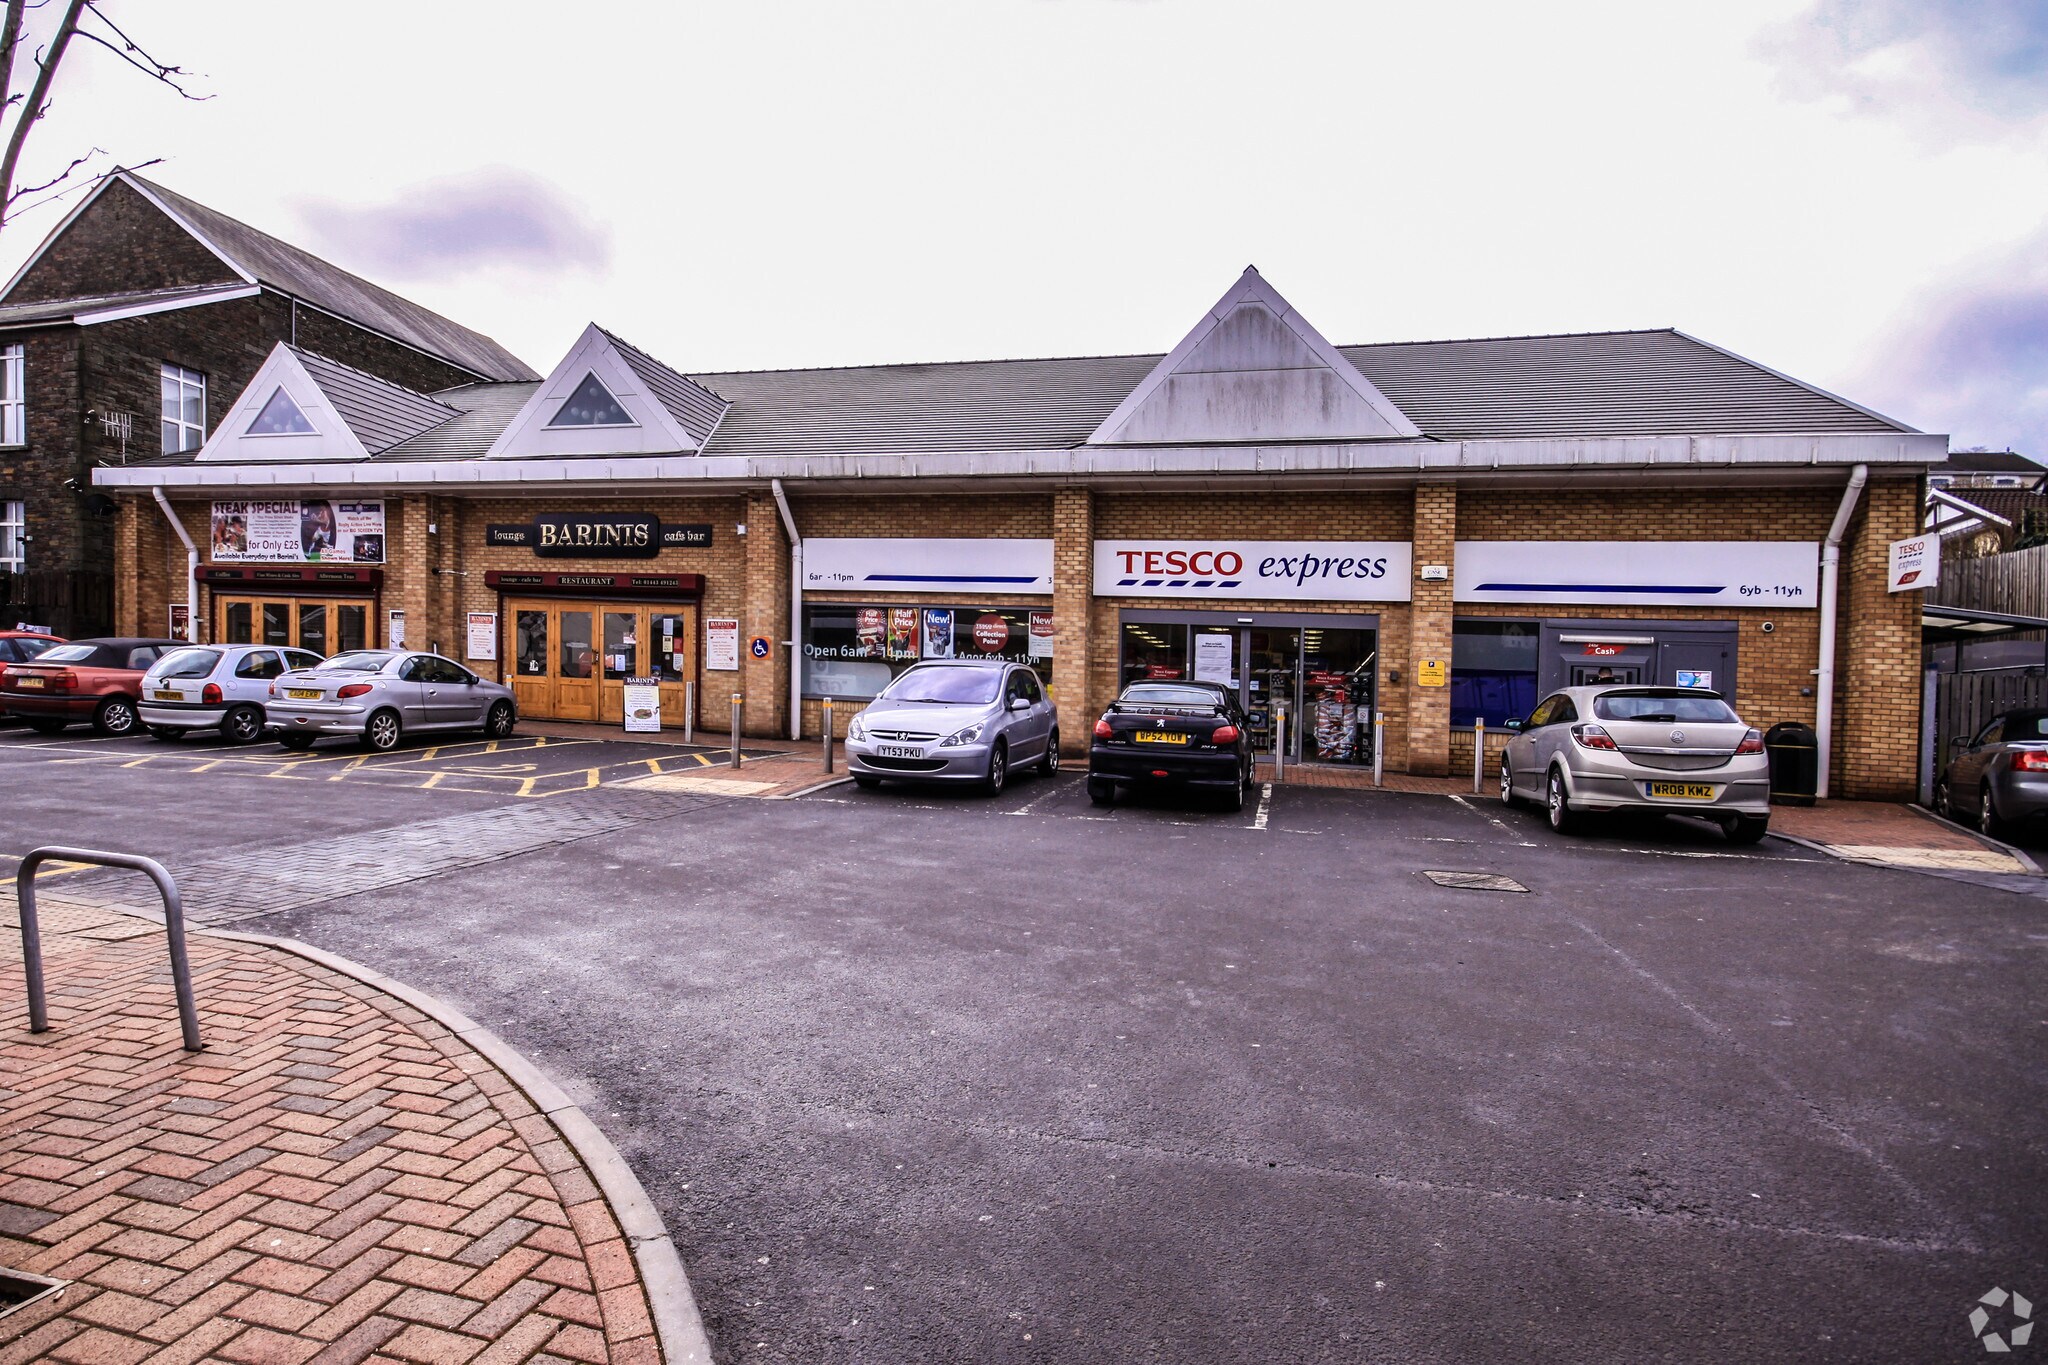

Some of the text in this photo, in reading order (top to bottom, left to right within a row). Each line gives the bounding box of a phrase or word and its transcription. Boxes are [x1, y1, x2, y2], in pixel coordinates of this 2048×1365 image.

[214, 501, 299, 514] STEAK SPECIAL
[494, 530, 525, 541] lounge
[539, 523, 649, 547] BARINIS
[664, 530, 705, 541] cafe bar
[248, 540, 299, 552] for Only £25
[1898, 541, 1925, 555] TESCO
[1116, 550, 1387, 587] TESCO express
[1897, 558, 1922, 571] express
[561, 576, 612, 585] RESTAURANT
[833, 573, 854, 582] 11pm
[1739, 585, 1762, 597] 6yb
[1773, 586, 1802, 598] 11yh
[896, 609, 913, 618] Half
[927, 613, 950, 624] New!
[894, 617, 914, 627] Price
[1032, 615, 1054, 625] New!
[975, 630, 1006, 638] Collection
[982, 637, 999, 645] Point
[804, 643, 837, 658] Open
[840, 644, 868, 658] 6am
[881, 644, 915, 661] 11pm
[1594, 647, 1615, 655] Cash
[1014, 652, 1040, 666] 11yh
[1139, 731, 1182, 742] WP52 YOW
[881, 747, 921, 758] YT53 PKU
[1653, 782, 1712, 797] WR08 KMZ
